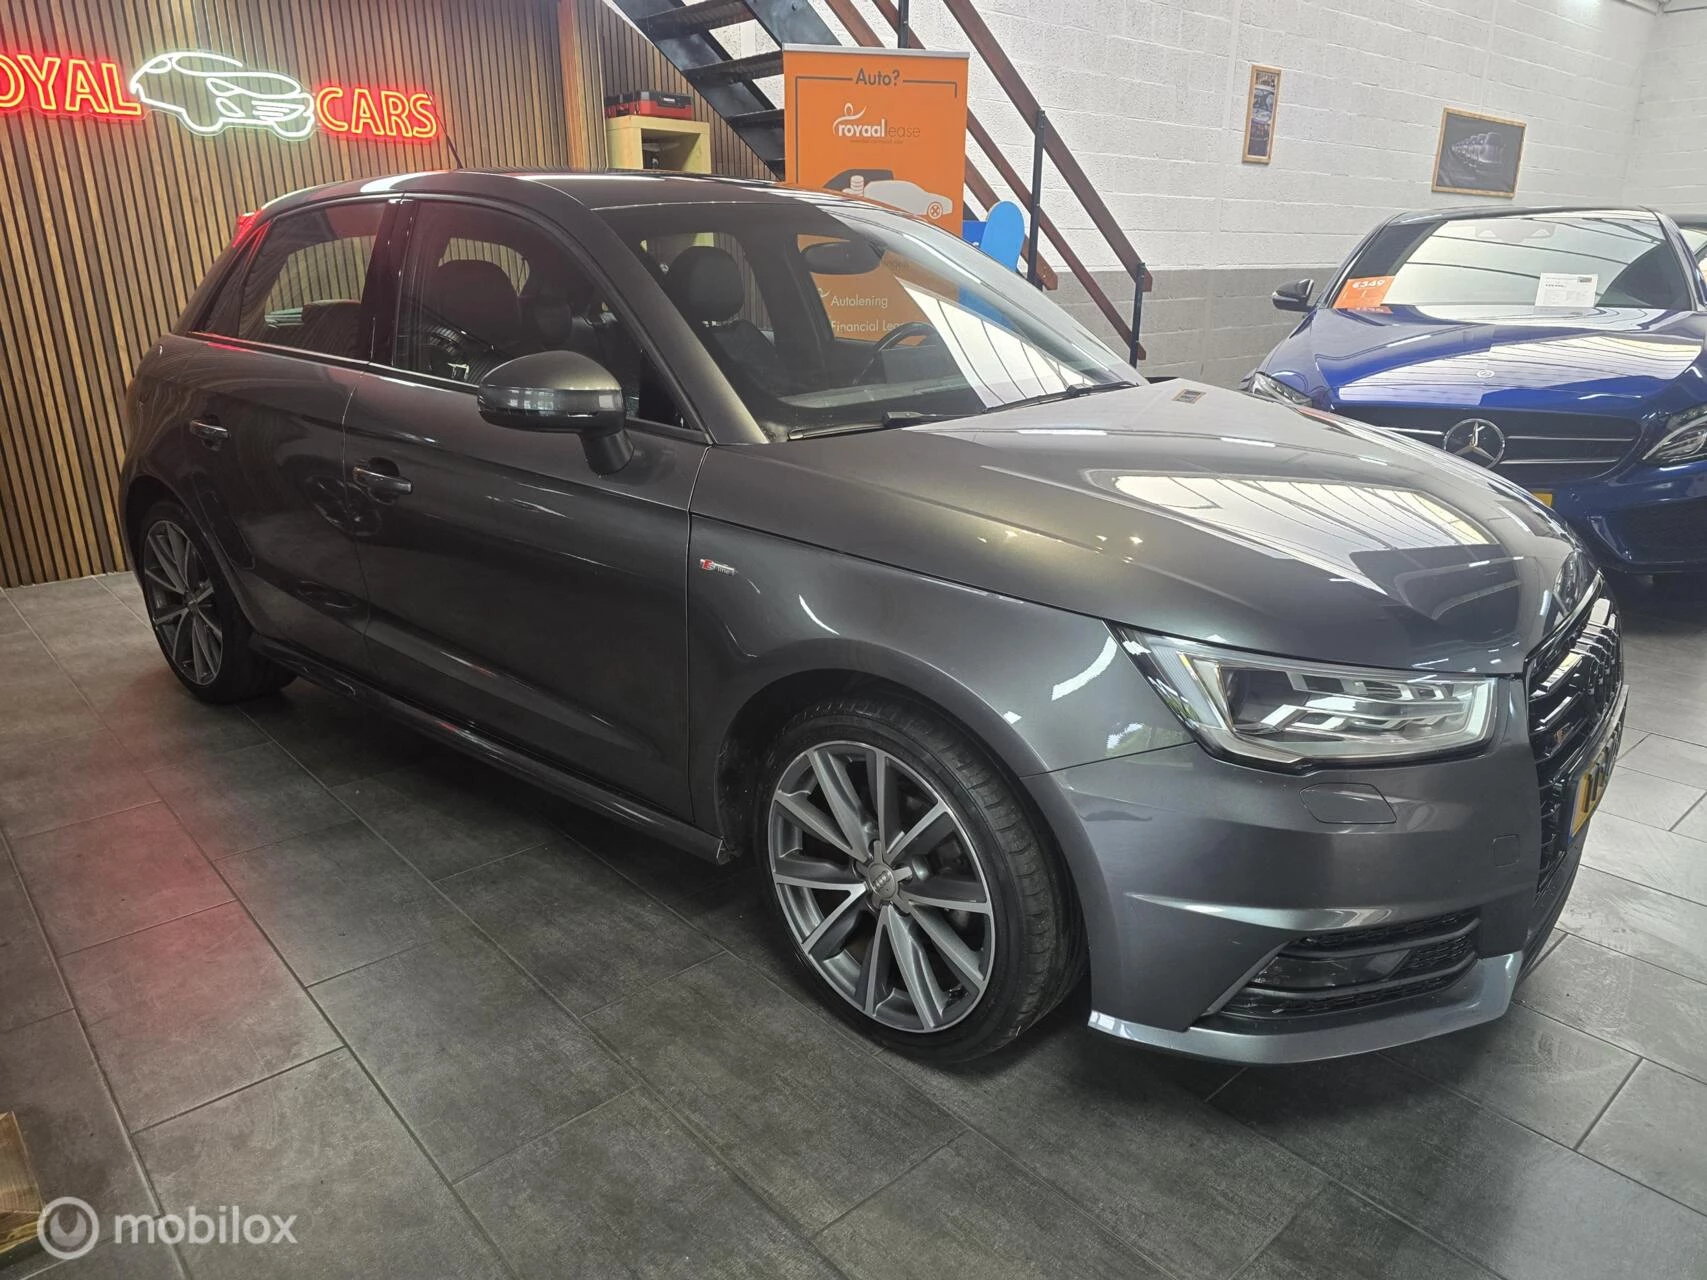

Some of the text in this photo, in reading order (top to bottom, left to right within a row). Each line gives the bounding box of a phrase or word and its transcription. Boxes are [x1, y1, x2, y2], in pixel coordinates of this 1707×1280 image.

[855, 67, 901, 86] Auto?
[315, 88, 438, 138] CARS
[830, 294, 888, 309] Autolening
[831, 319, 879, 332] Financial
